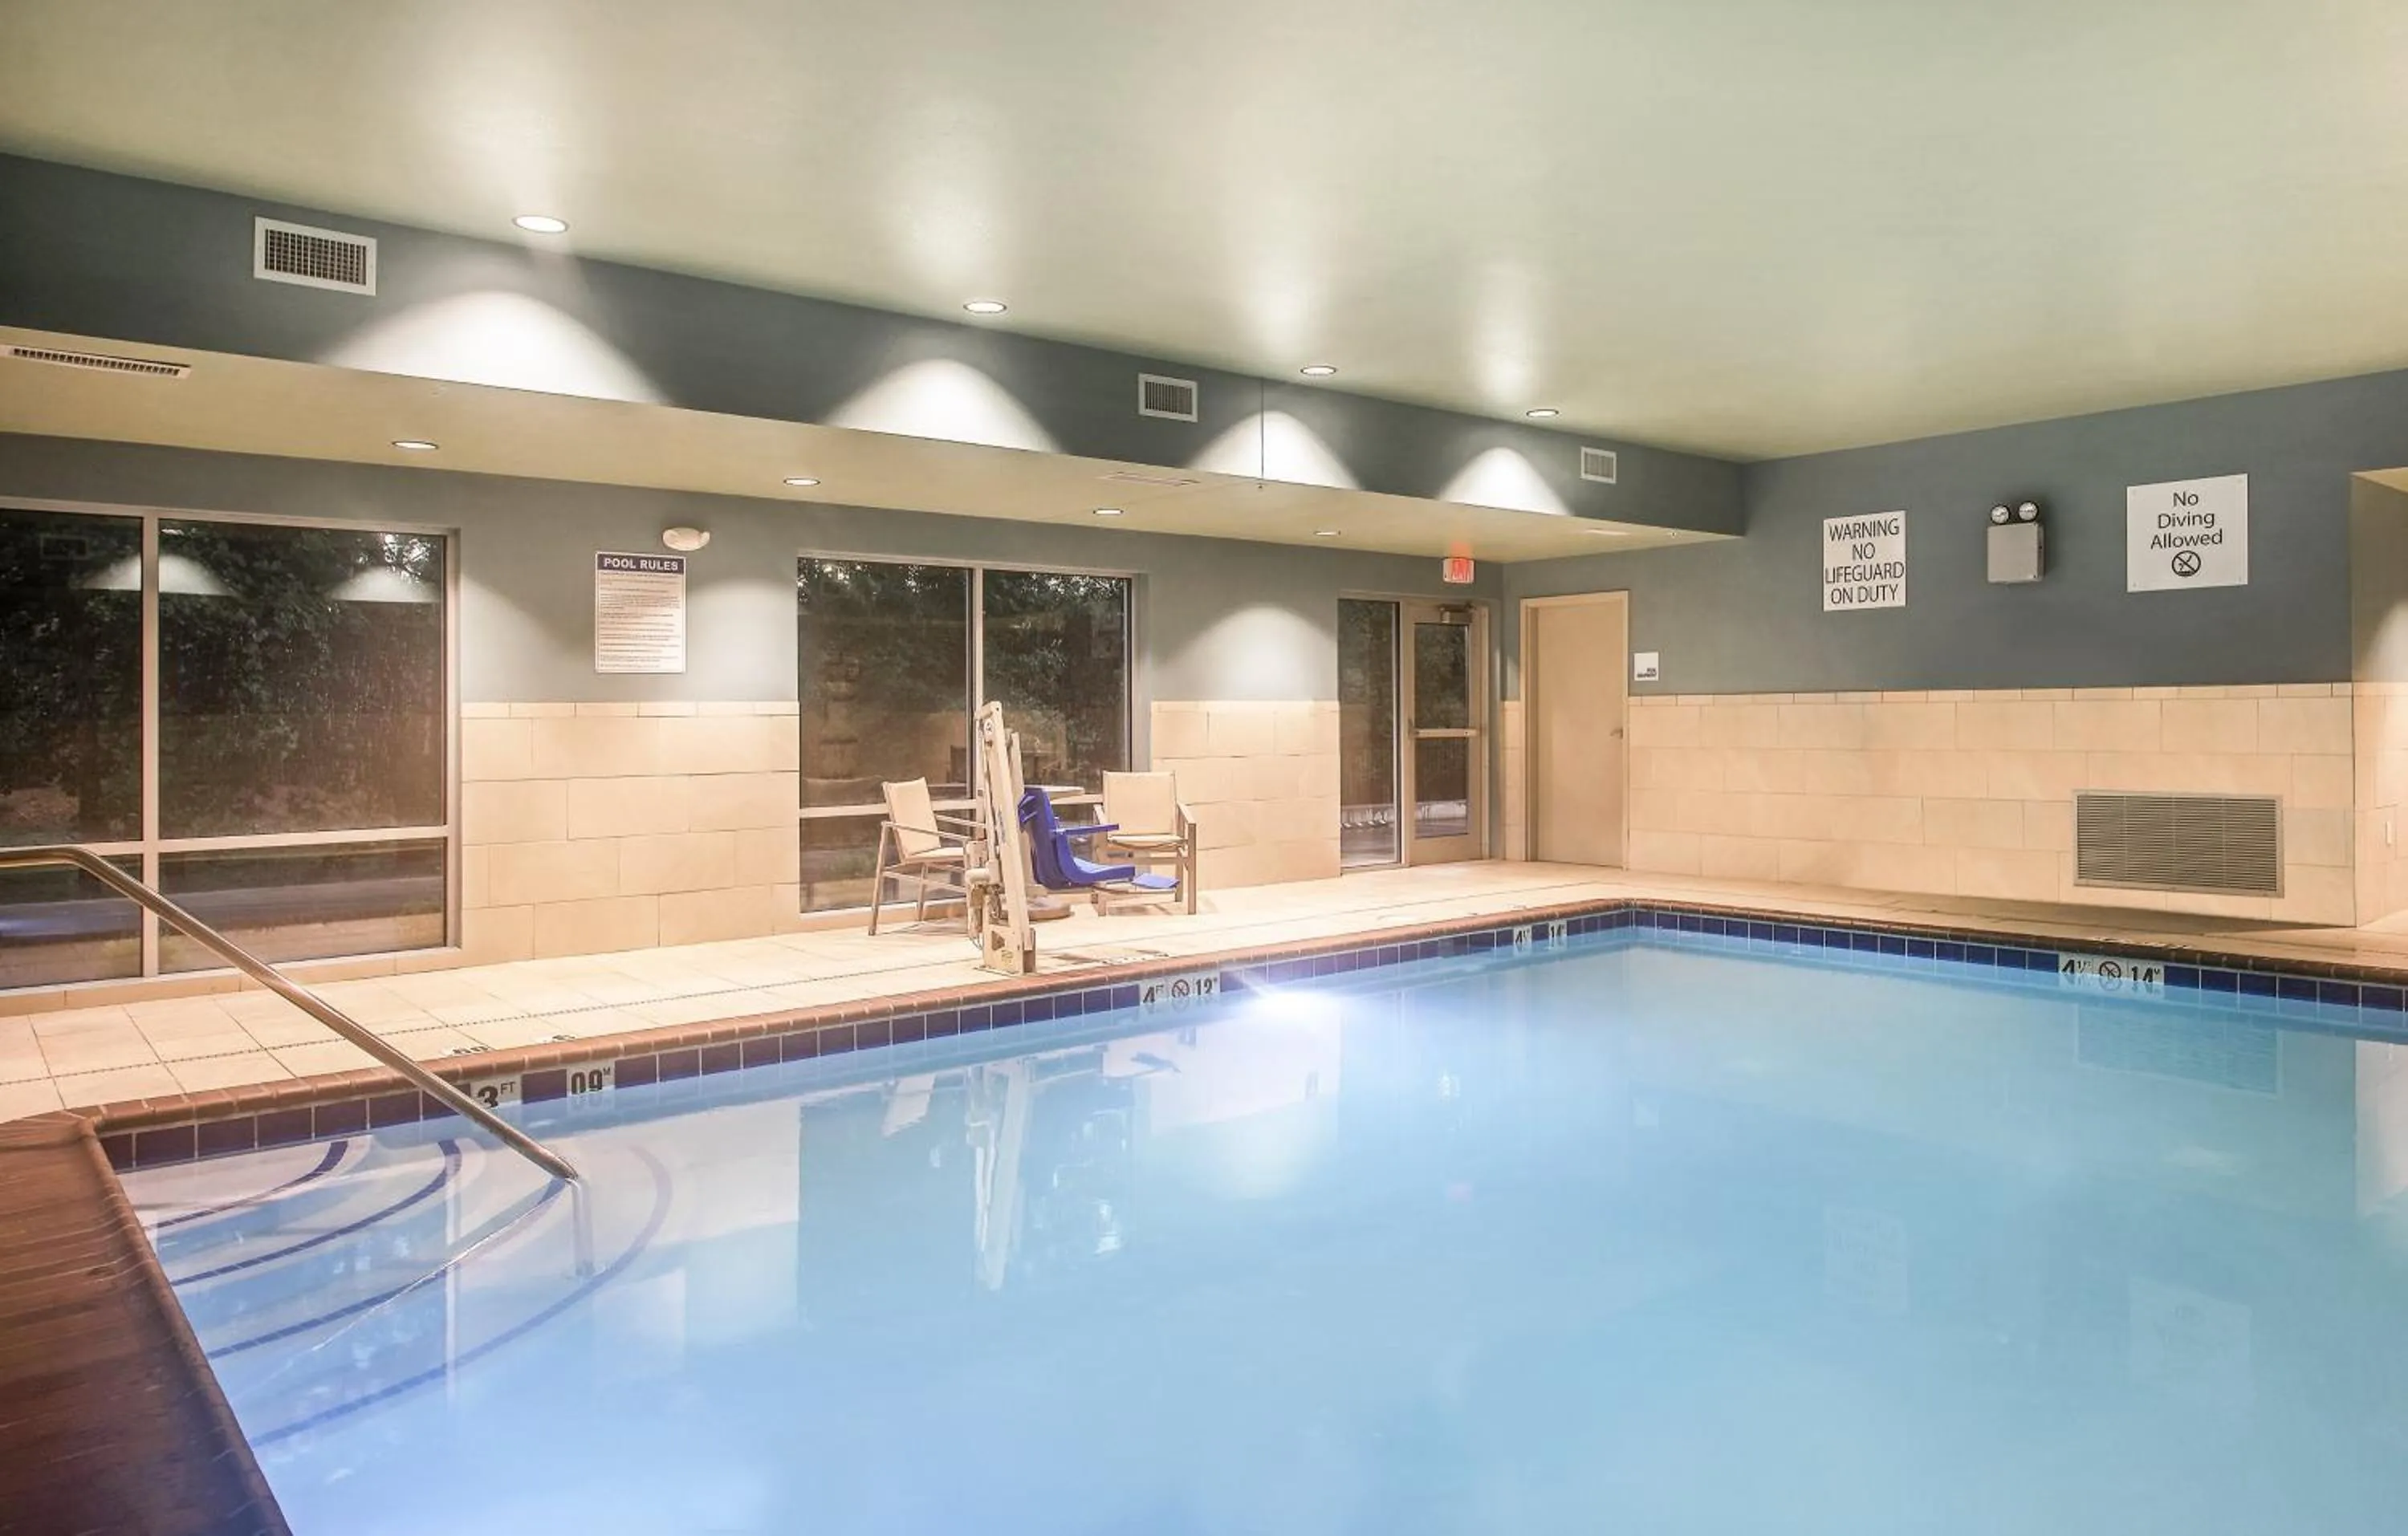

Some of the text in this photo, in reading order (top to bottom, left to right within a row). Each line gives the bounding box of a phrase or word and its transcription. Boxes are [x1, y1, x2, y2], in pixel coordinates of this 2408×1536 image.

[2173, 491, 2199, 507] No
[2158, 511, 2215, 529] Diving
[1828, 518, 1900, 542] WARNING
[2150, 528, 2223, 550] Allowed
[1853, 542, 1876, 560] NO
[604, 558, 678, 571] POOL RULES
[1825, 561, 1905, 584] LIFEGUARD
[1831, 583, 1898, 603] ON DUTY
